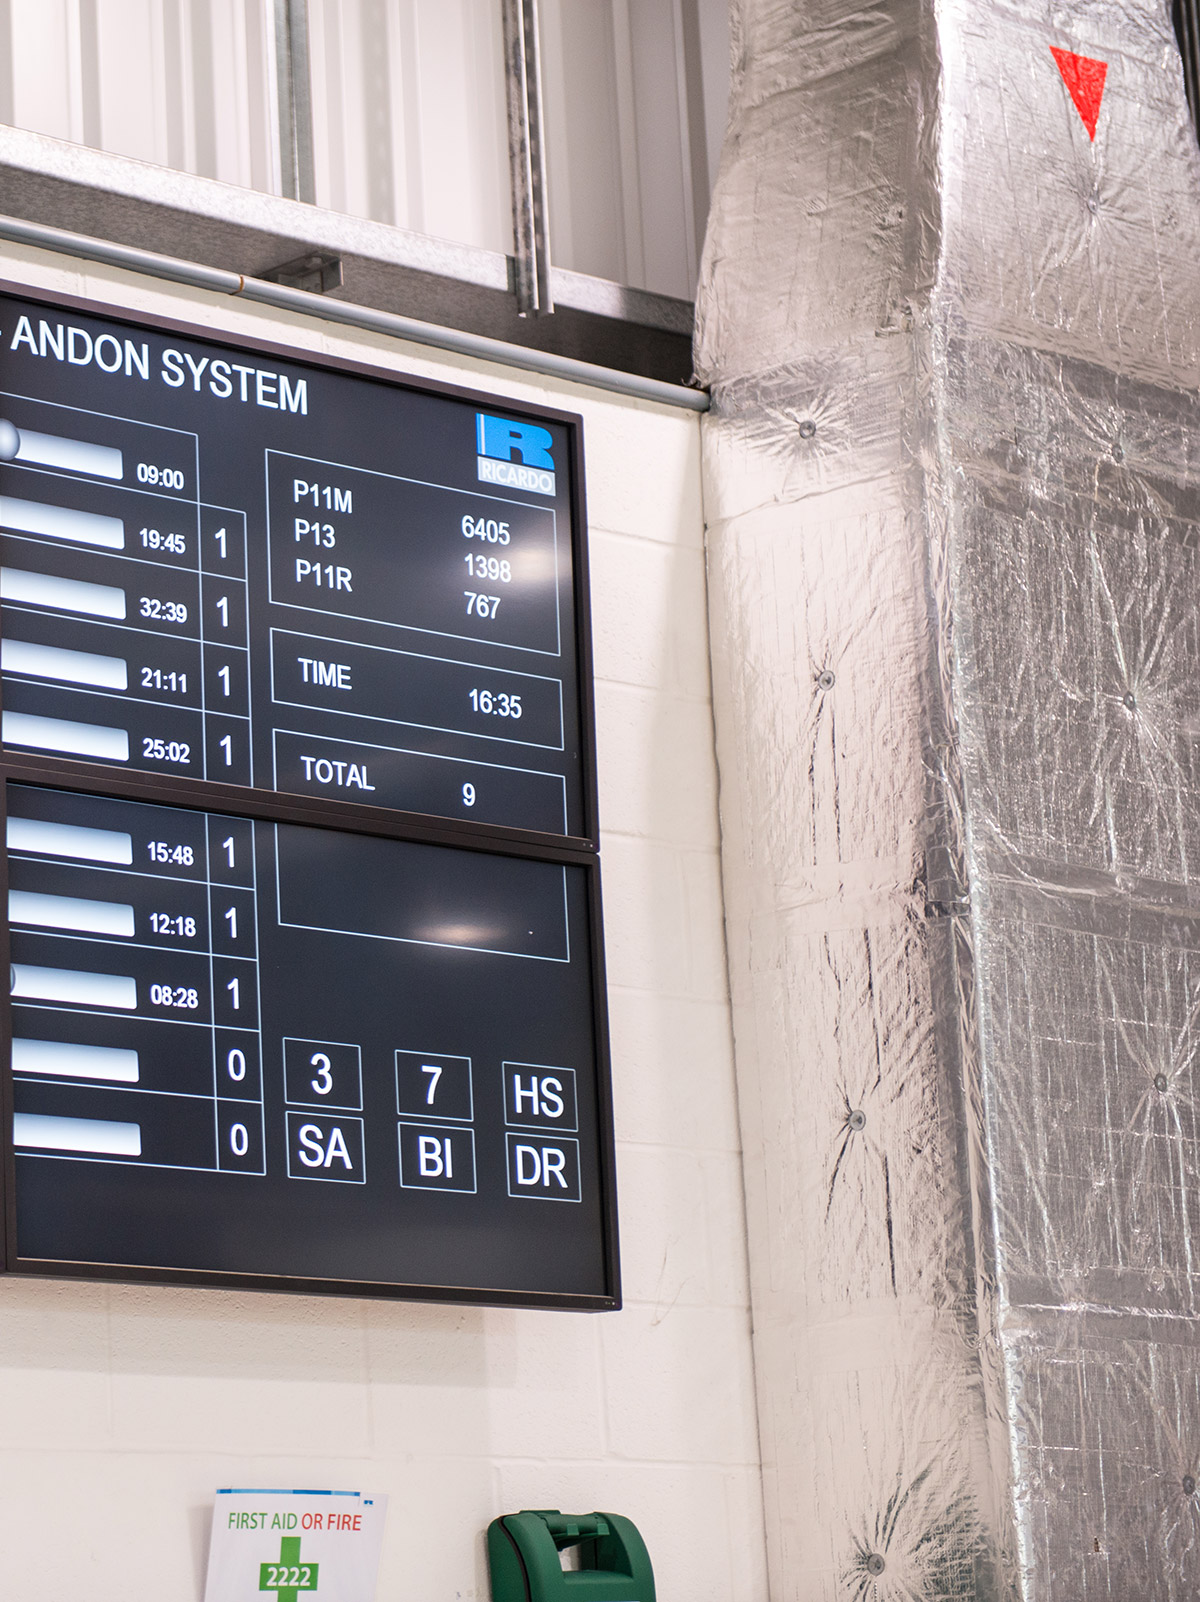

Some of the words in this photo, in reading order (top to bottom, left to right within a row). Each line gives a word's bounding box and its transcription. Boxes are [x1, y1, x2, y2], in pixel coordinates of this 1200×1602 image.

[9, 315, 150, 380] ANDON
[161, 348, 308, 416] SYSTEM
[136, 462, 185, 490] 09:00
[482, 461, 553, 493] RICARDO
[293, 479, 353, 514] P11M
[461, 515, 510, 545] 6405
[139, 527, 186, 554] 19:45
[214, 527, 227, 559] 1
[294, 517, 336, 548] P13
[463, 553, 512, 582] 1398
[295, 558, 353, 593] P11R
[463, 592, 500, 619] 767
[139, 596, 188, 624] 32:39
[216, 596, 229, 628] 1
[140, 666, 187, 694] 21:11
[218, 665, 230, 697] 1
[297, 657, 353, 690] TIME
[469, 688, 523, 719] 16:35
[142, 737, 191, 764] 25:02
[219, 734, 232, 766] 1
[300, 755, 376, 791] TOTAL
[462, 782, 476, 807] 9
[147, 841, 194, 866] 15:48
[222, 836, 235, 868] 1
[149, 912, 197, 938] 12:18
[225, 907, 238, 939] 1
[150, 984, 199, 1009] 08:28
[227, 977, 240, 1010] 1
[227, 1049, 246, 1081] 0
[310, 1053, 333, 1095] 3
[421, 1065, 443, 1105] 7
[514, 1074, 564, 1118] HS
[230, 1123, 249, 1156] 0
[298, 1124, 353, 1170] SA
[418, 1135, 453, 1179] BI
[515, 1145, 569, 1189] DR
[228, 1512, 268, 1530] FIRST
[271, 1513, 297, 1530] AID
[302, 1513, 324, 1530] OR
[327, 1514, 362, 1531] FIRE
[266, 1567, 311, 1588] 2222
